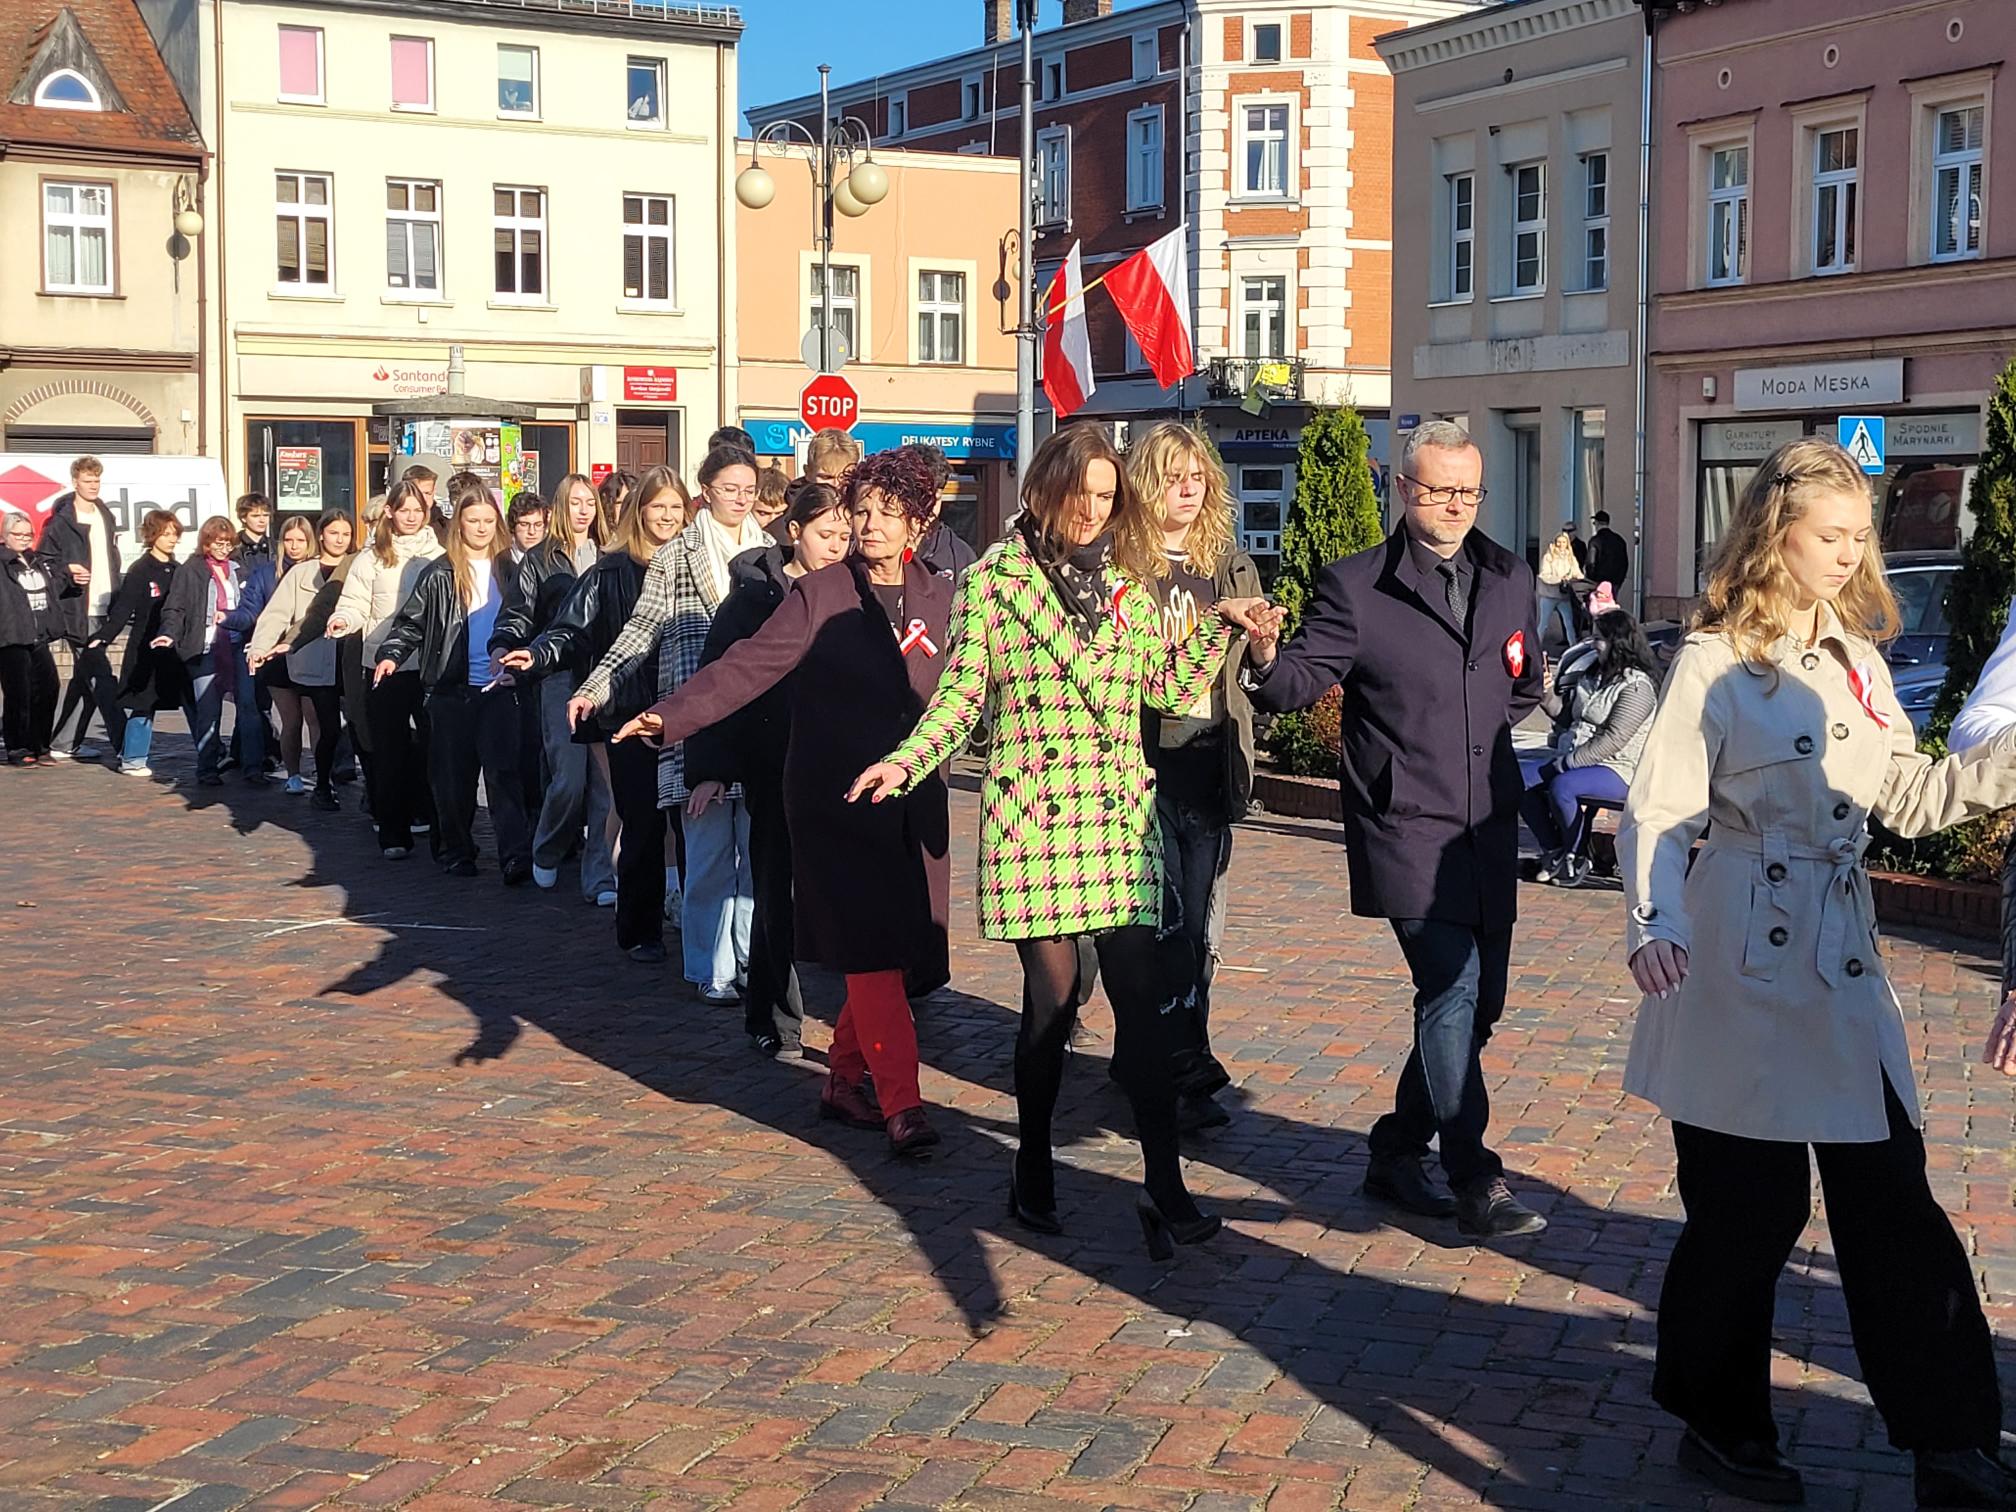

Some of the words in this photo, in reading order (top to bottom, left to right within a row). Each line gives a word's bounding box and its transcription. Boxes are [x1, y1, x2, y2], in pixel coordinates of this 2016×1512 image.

[392, 369, 449, 382] Santand
[393, 384, 435, 393] Consumer
[1762, 379, 1807, 395] MODA
[1814, 375, 1870, 392] MĘSKA
[806, 396, 854, 417] STOP
[1899, 422, 1949, 434] SPODNIE
[901, 435, 959, 447] DELIKATESY
[962, 436, 995, 448] RYBNE
[1235, 429, 1290, 441] APTEKA
[1893, 435, 1954, 446] MARYNARKI
[106, 488, 198, 543] dpd
